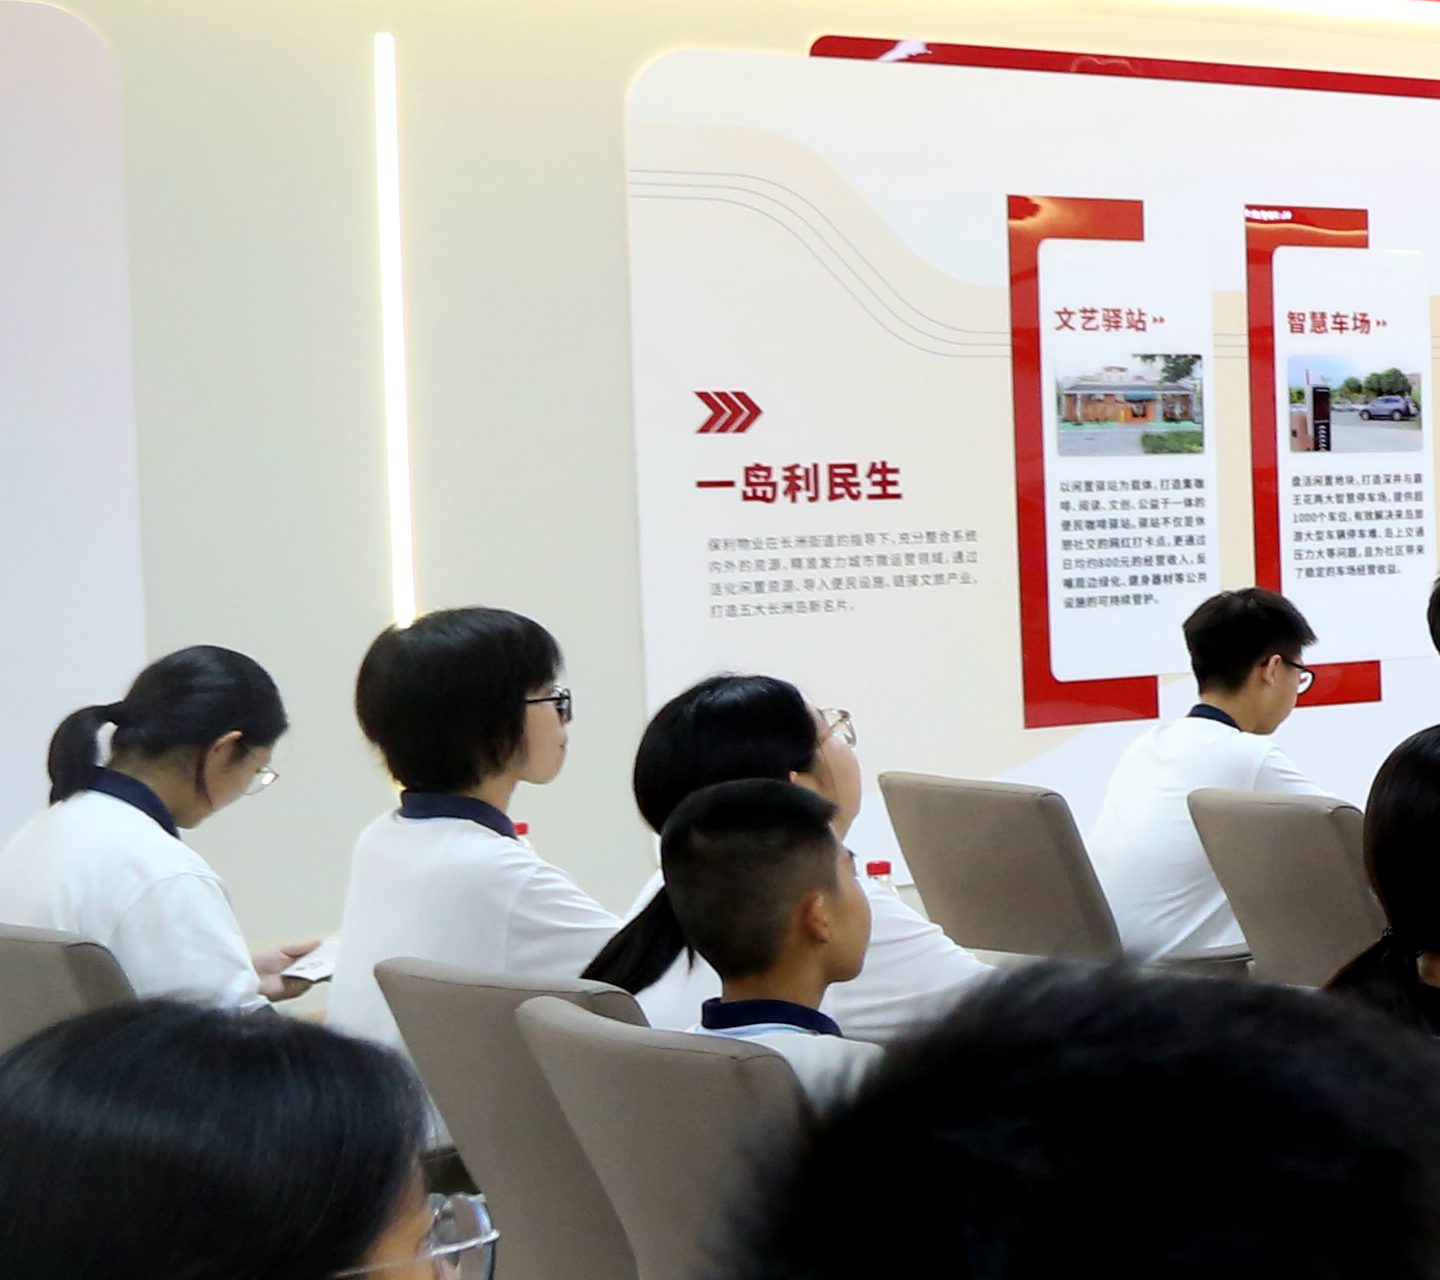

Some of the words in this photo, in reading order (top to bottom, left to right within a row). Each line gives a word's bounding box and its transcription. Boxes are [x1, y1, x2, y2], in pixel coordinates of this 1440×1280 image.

[1053, 306, 1148, 333] 文艺驿站
[1287, 310, 1372, 335] 智慧车场
[695, 460, 903, 504] 一岛利民生
